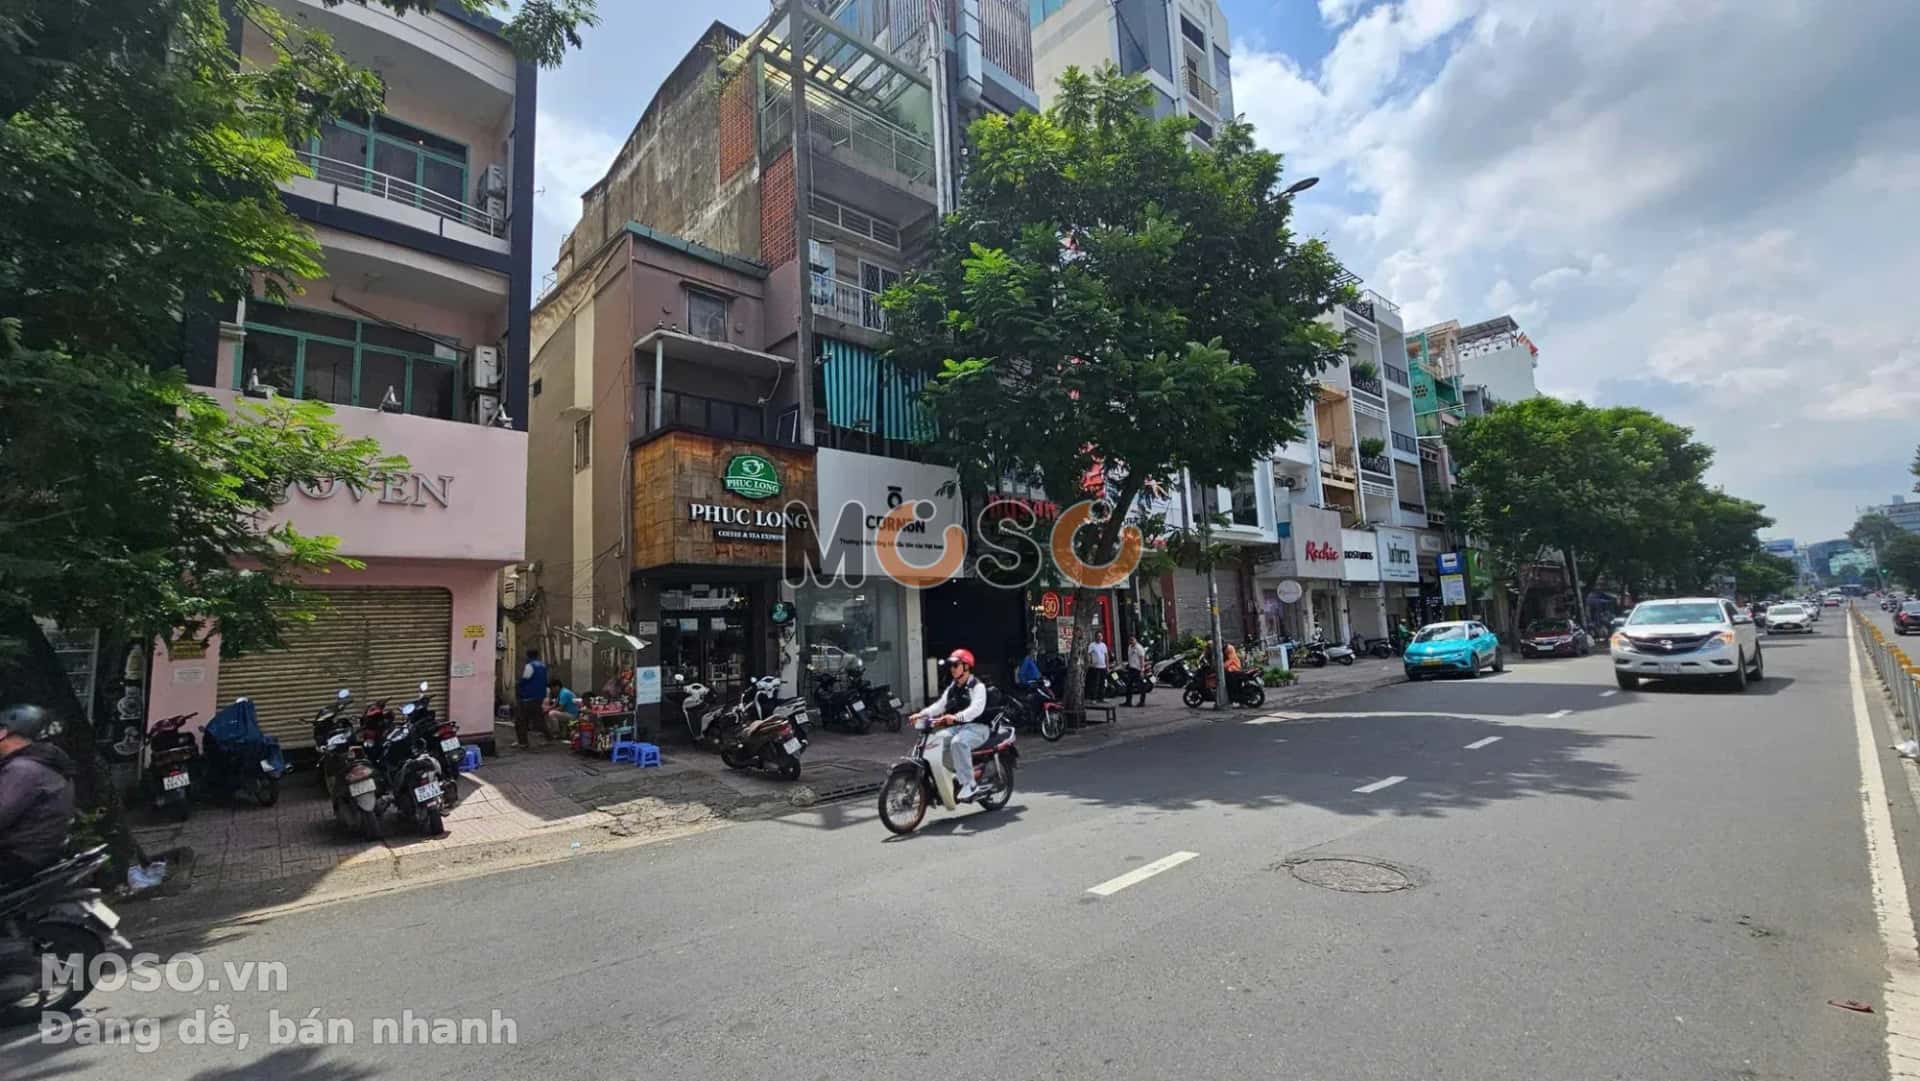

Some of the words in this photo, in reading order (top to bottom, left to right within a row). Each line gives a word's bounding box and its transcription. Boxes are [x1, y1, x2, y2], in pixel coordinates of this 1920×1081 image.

[727, 479, 753, 489] PHUC
[754, 481, 779, 494] LONG
[690, 503, 751, 526] PHUC
[755, 509, 809, 530] LONG
